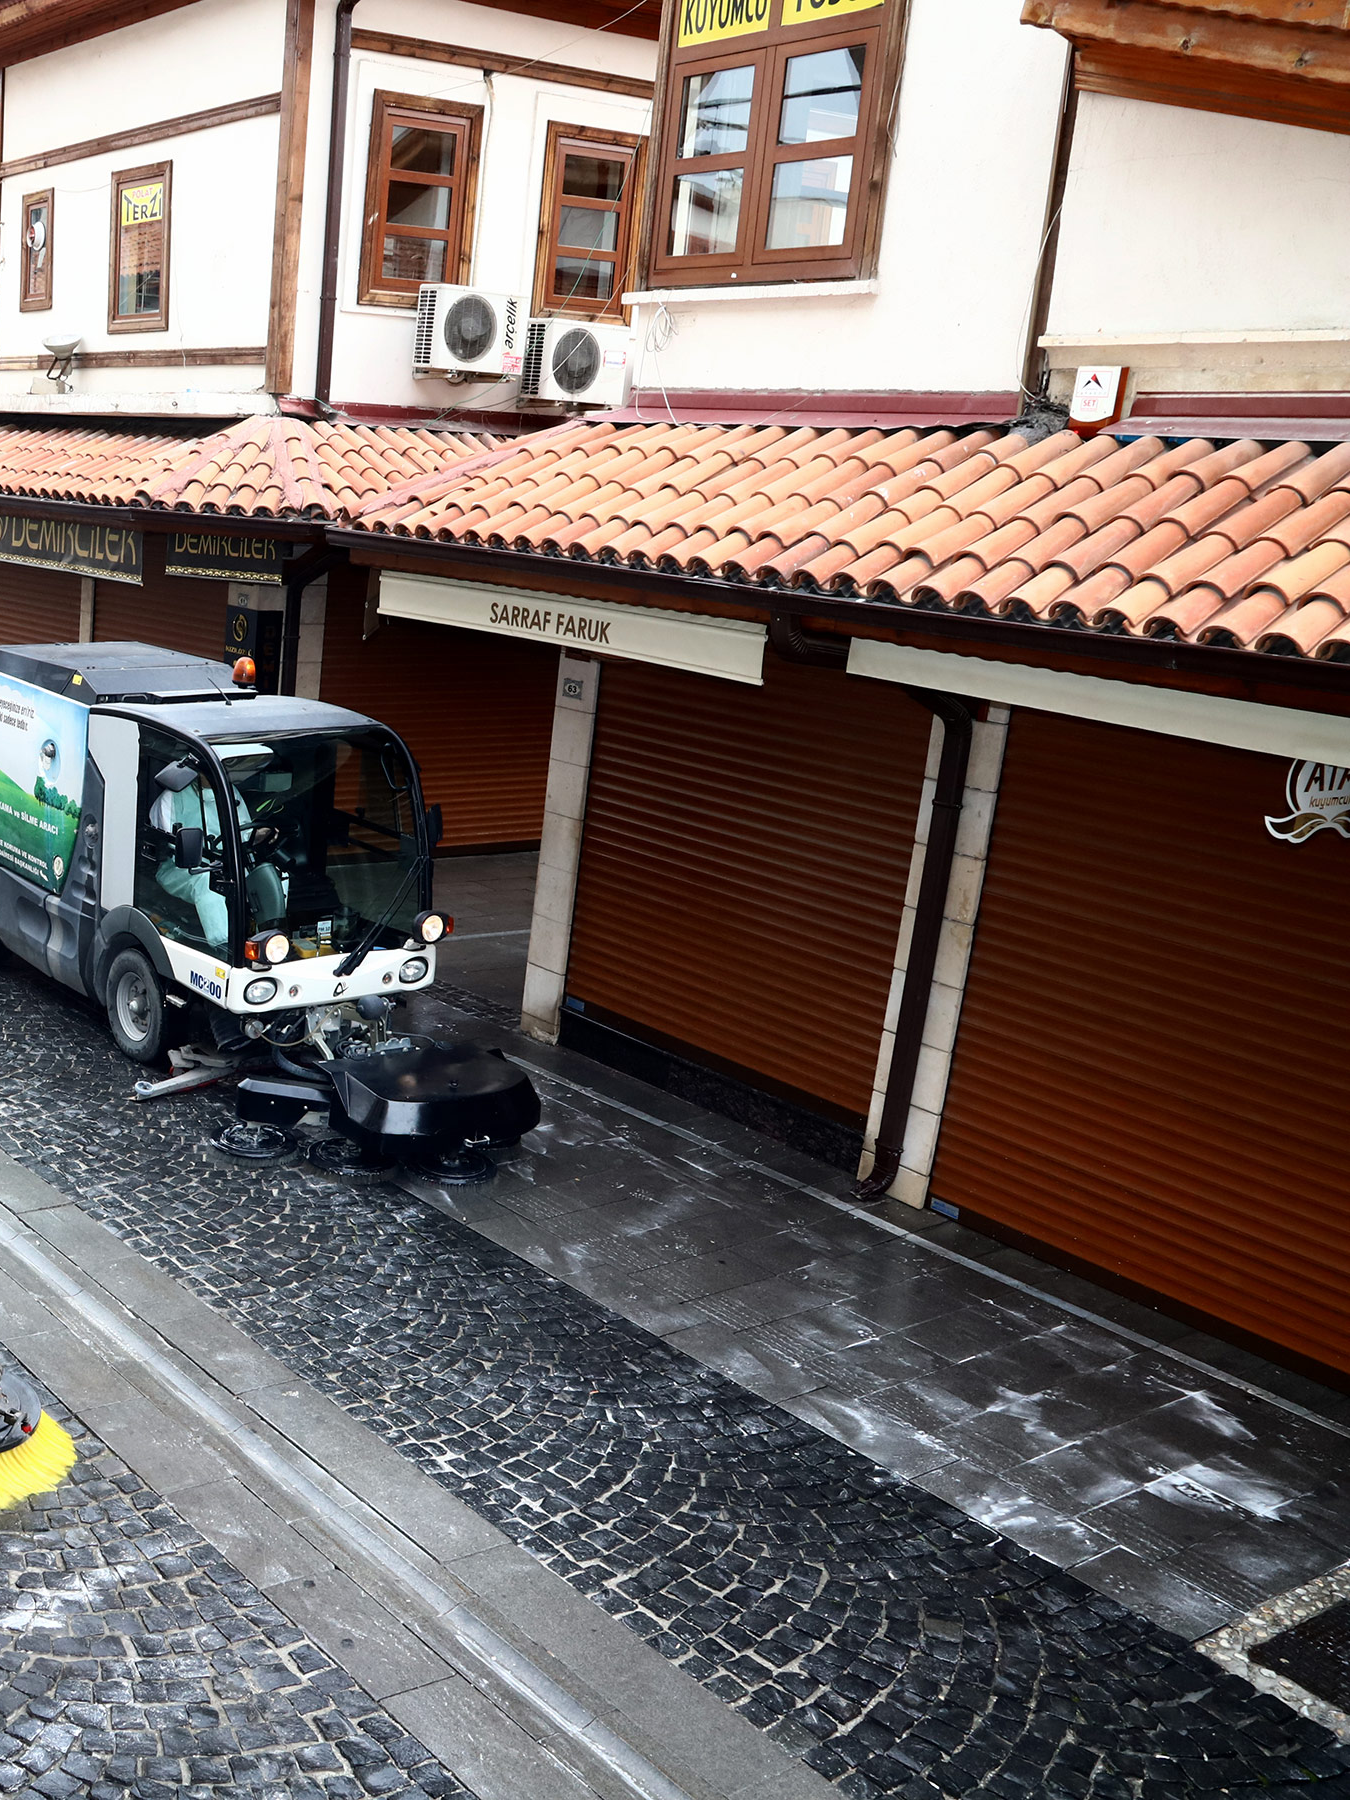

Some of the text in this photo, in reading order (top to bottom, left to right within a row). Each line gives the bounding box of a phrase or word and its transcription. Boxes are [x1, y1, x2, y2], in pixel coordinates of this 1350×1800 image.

[132, 187, 153, 199] POLAT
[504, 297, 518, 350] arçelik
[490, 602, 611, 644] SARRAF FARUK
[567, 684, 578, 694] 63
[1308, 795, 1350, 810] kuyumcu
[13, 809, 21, 819] ve
[39, 820, 59, 836] ARACI
